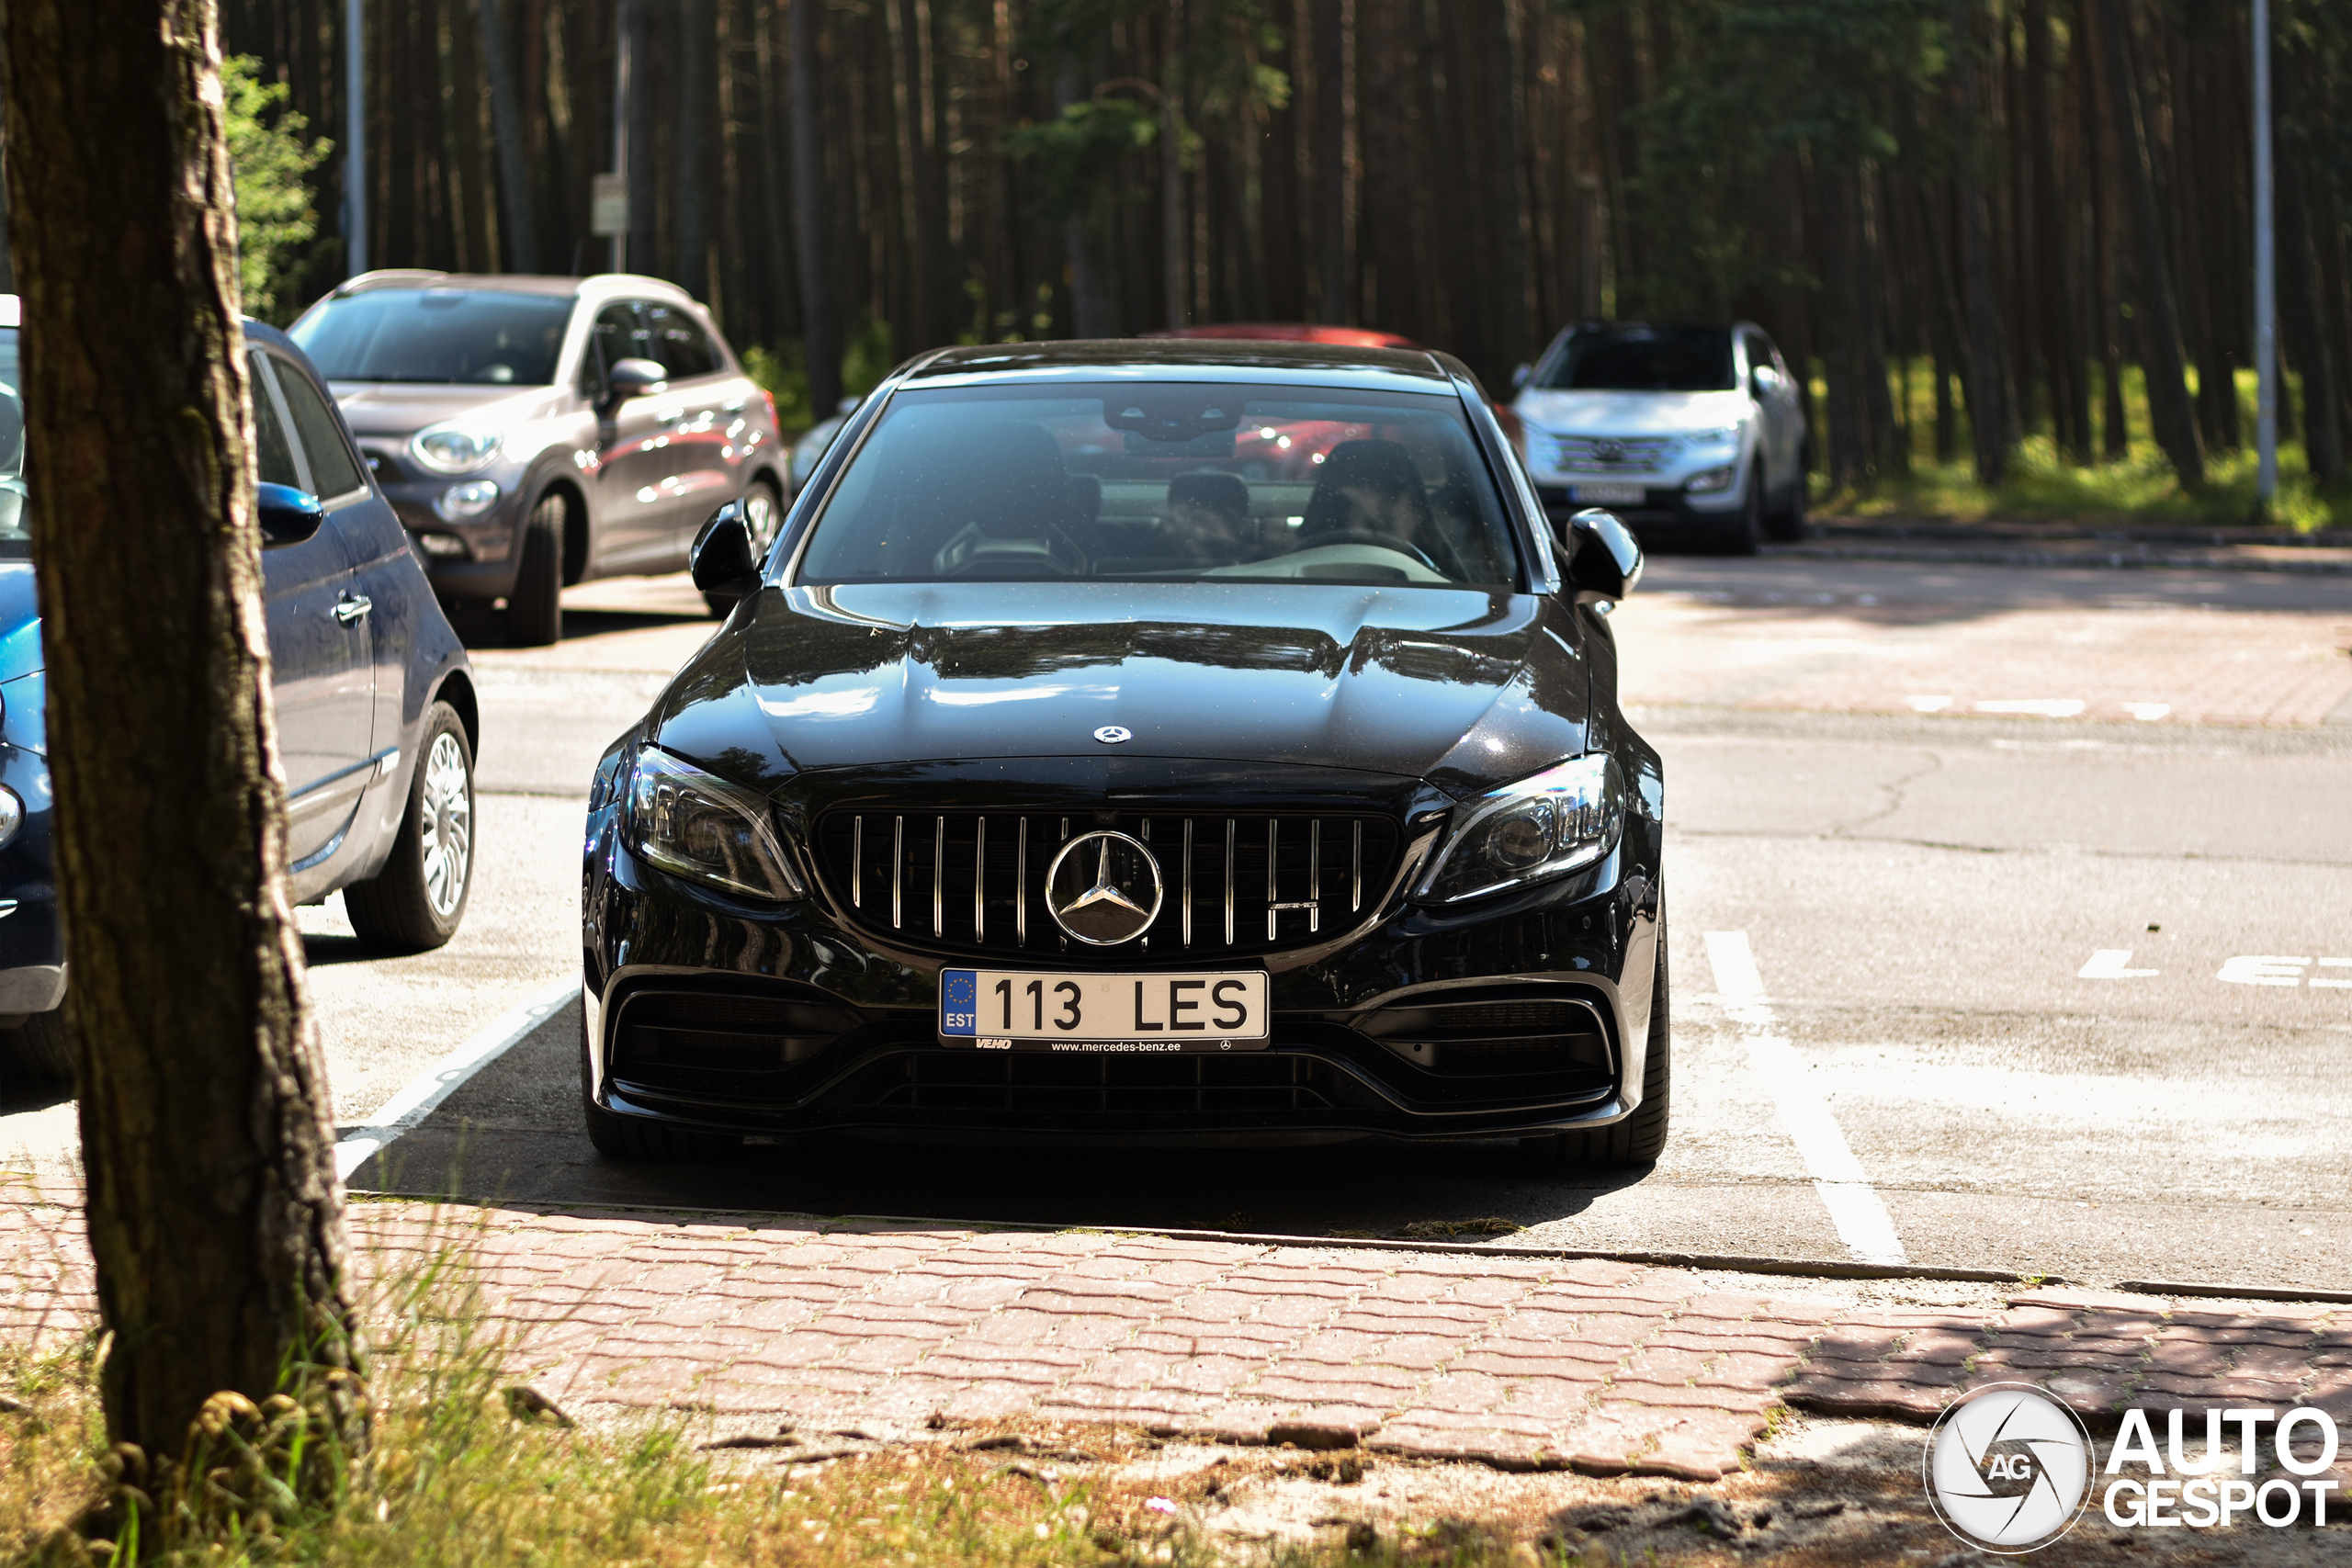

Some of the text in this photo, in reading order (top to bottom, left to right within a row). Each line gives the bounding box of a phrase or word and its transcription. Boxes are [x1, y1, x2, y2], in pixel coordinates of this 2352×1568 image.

[995, 979, 1248, 1031] 113 LES
[946, 1013, 975, 1028] EST
[976, 1038, 1012, 1050] VEHO
[1051, 1042, 1182, 1053] www.mercedes-benz.ee
